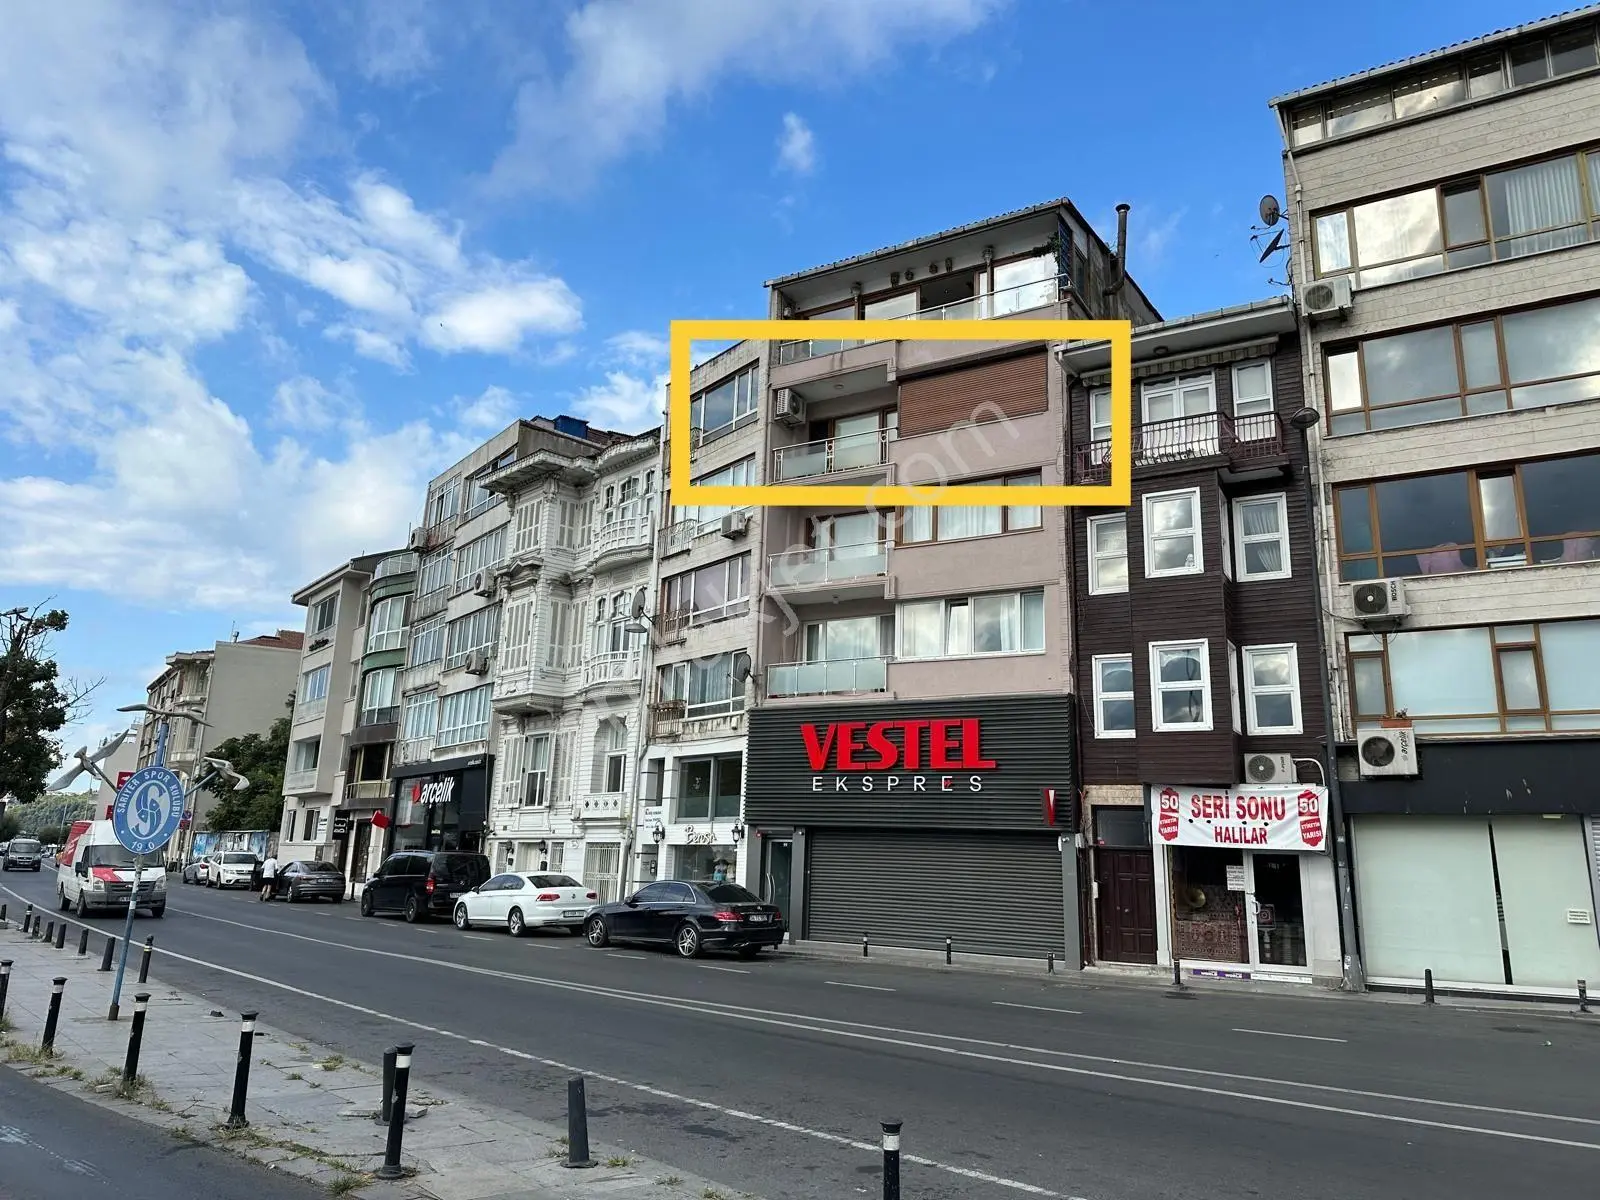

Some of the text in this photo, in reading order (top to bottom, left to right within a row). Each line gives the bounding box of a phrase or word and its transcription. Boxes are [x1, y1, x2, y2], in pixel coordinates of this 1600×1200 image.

[800, 718, 997, 771] VESTEL
[117, 778, 140, 813] SARIYER
[143, 770, 171, 783] SPOR
[420, 776, 455, 809] arçelik
[812, 775, 983, 792] EKSPRES
[1161, 795, 1179, 809] 50
[1191, 790, 1286, 820] SERİ SONU
[1299, 798, 1318, 813] 50
[1214, 826, 1268, 844] HALILAR
[131, 841, 155, 852] 190
